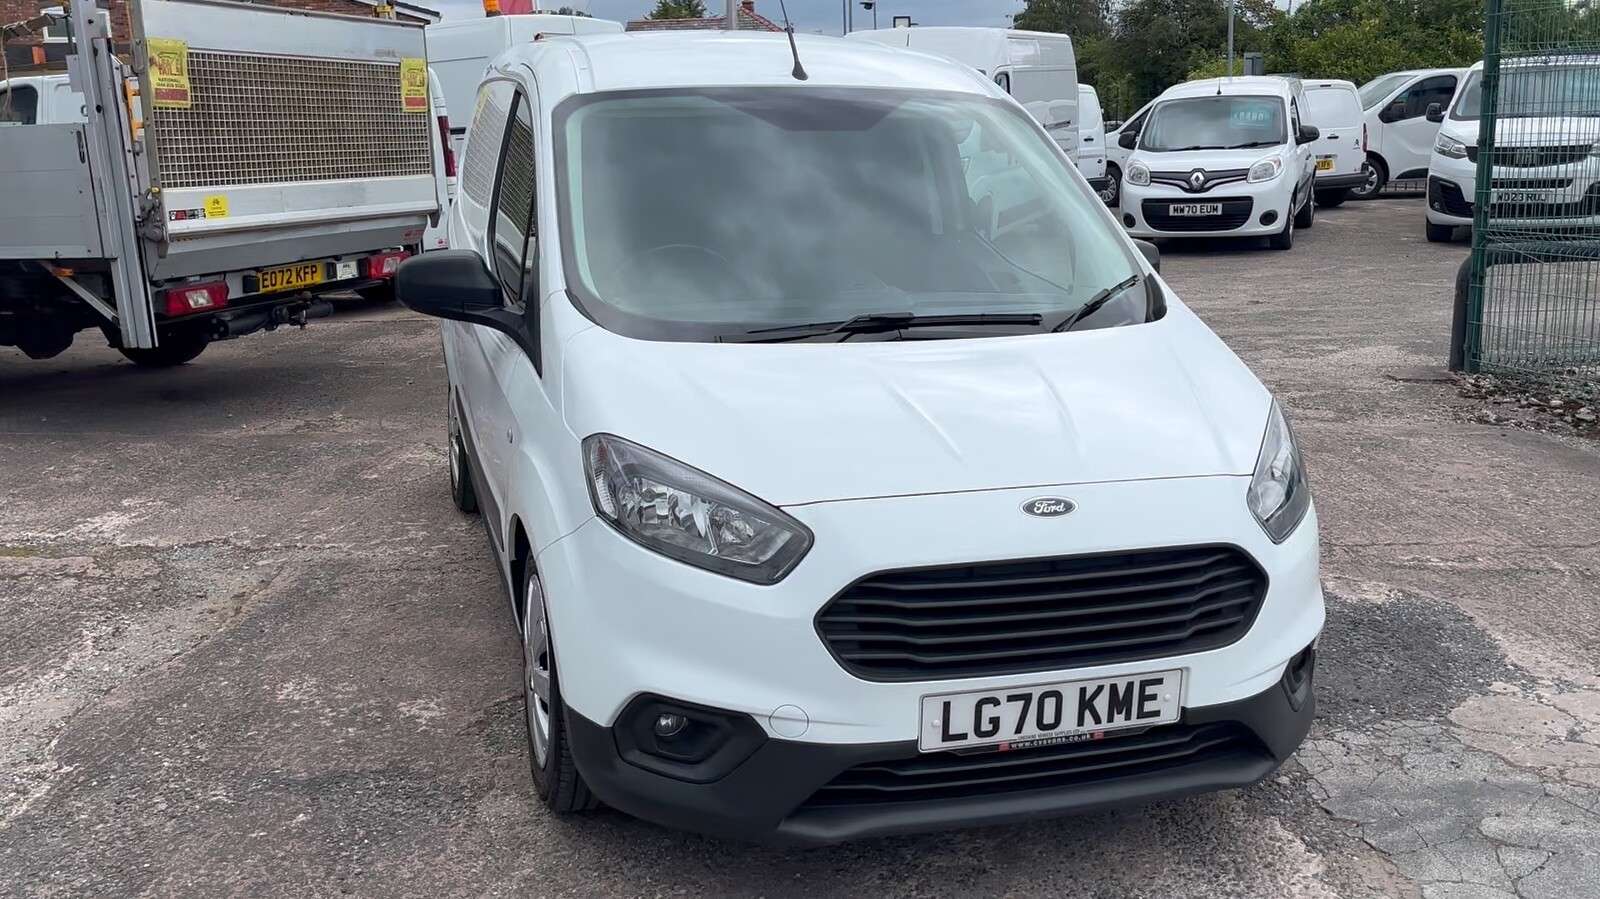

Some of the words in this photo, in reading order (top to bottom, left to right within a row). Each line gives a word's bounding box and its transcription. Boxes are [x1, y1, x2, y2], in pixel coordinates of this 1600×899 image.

[1172, 204, 1198, 215] MW70
[1200, 204, 1219, 214] EUM
[261, 268, 292, 289] EO72
[295, 264, 318, 283] KFP
[1033, 500, 1066, 514] Ford
[941, 690, 1064, 743] LG70
[1077, 677, 1164, 727] KME
